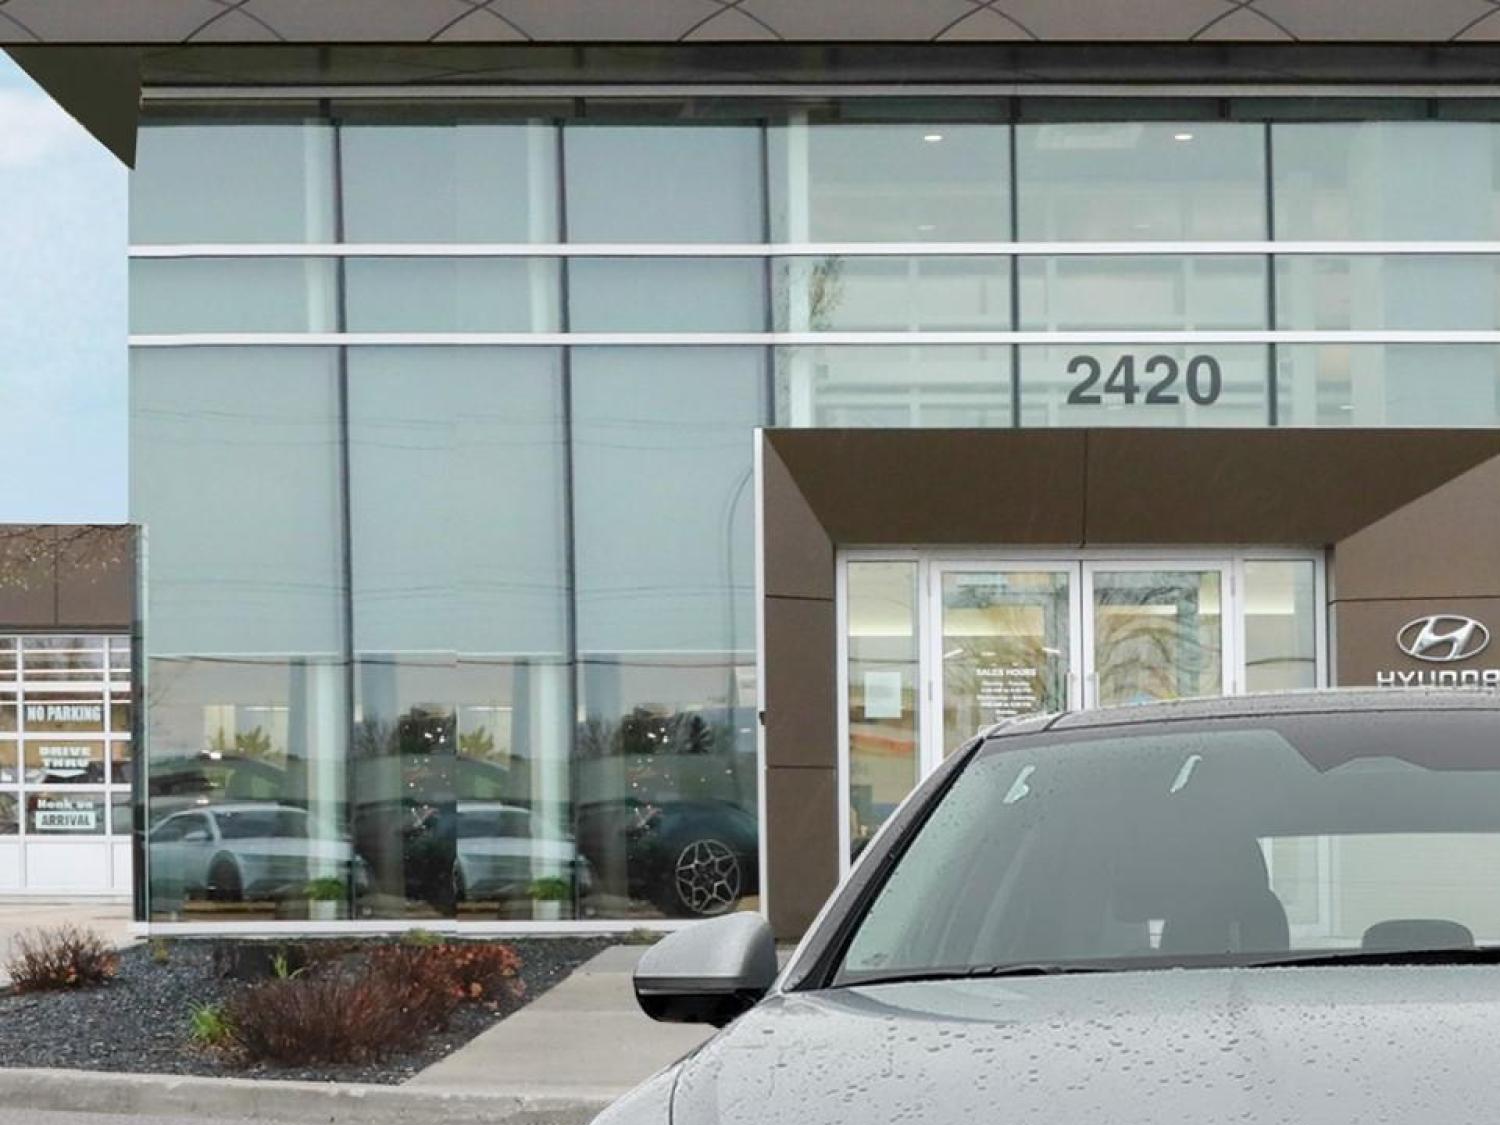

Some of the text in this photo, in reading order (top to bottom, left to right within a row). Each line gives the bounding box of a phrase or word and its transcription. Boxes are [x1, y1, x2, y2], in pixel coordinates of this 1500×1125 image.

[1066, 354, 1223, 406] 2420
[976, 668, 1036, 676] SALES HOURS
[27, 705, 101, 722] NO PARKING
[39, 746, 91, 757] DRIVE
[43, 758, 89, 768] THRU
[41, 814, 91, 826] ARRIVAL
